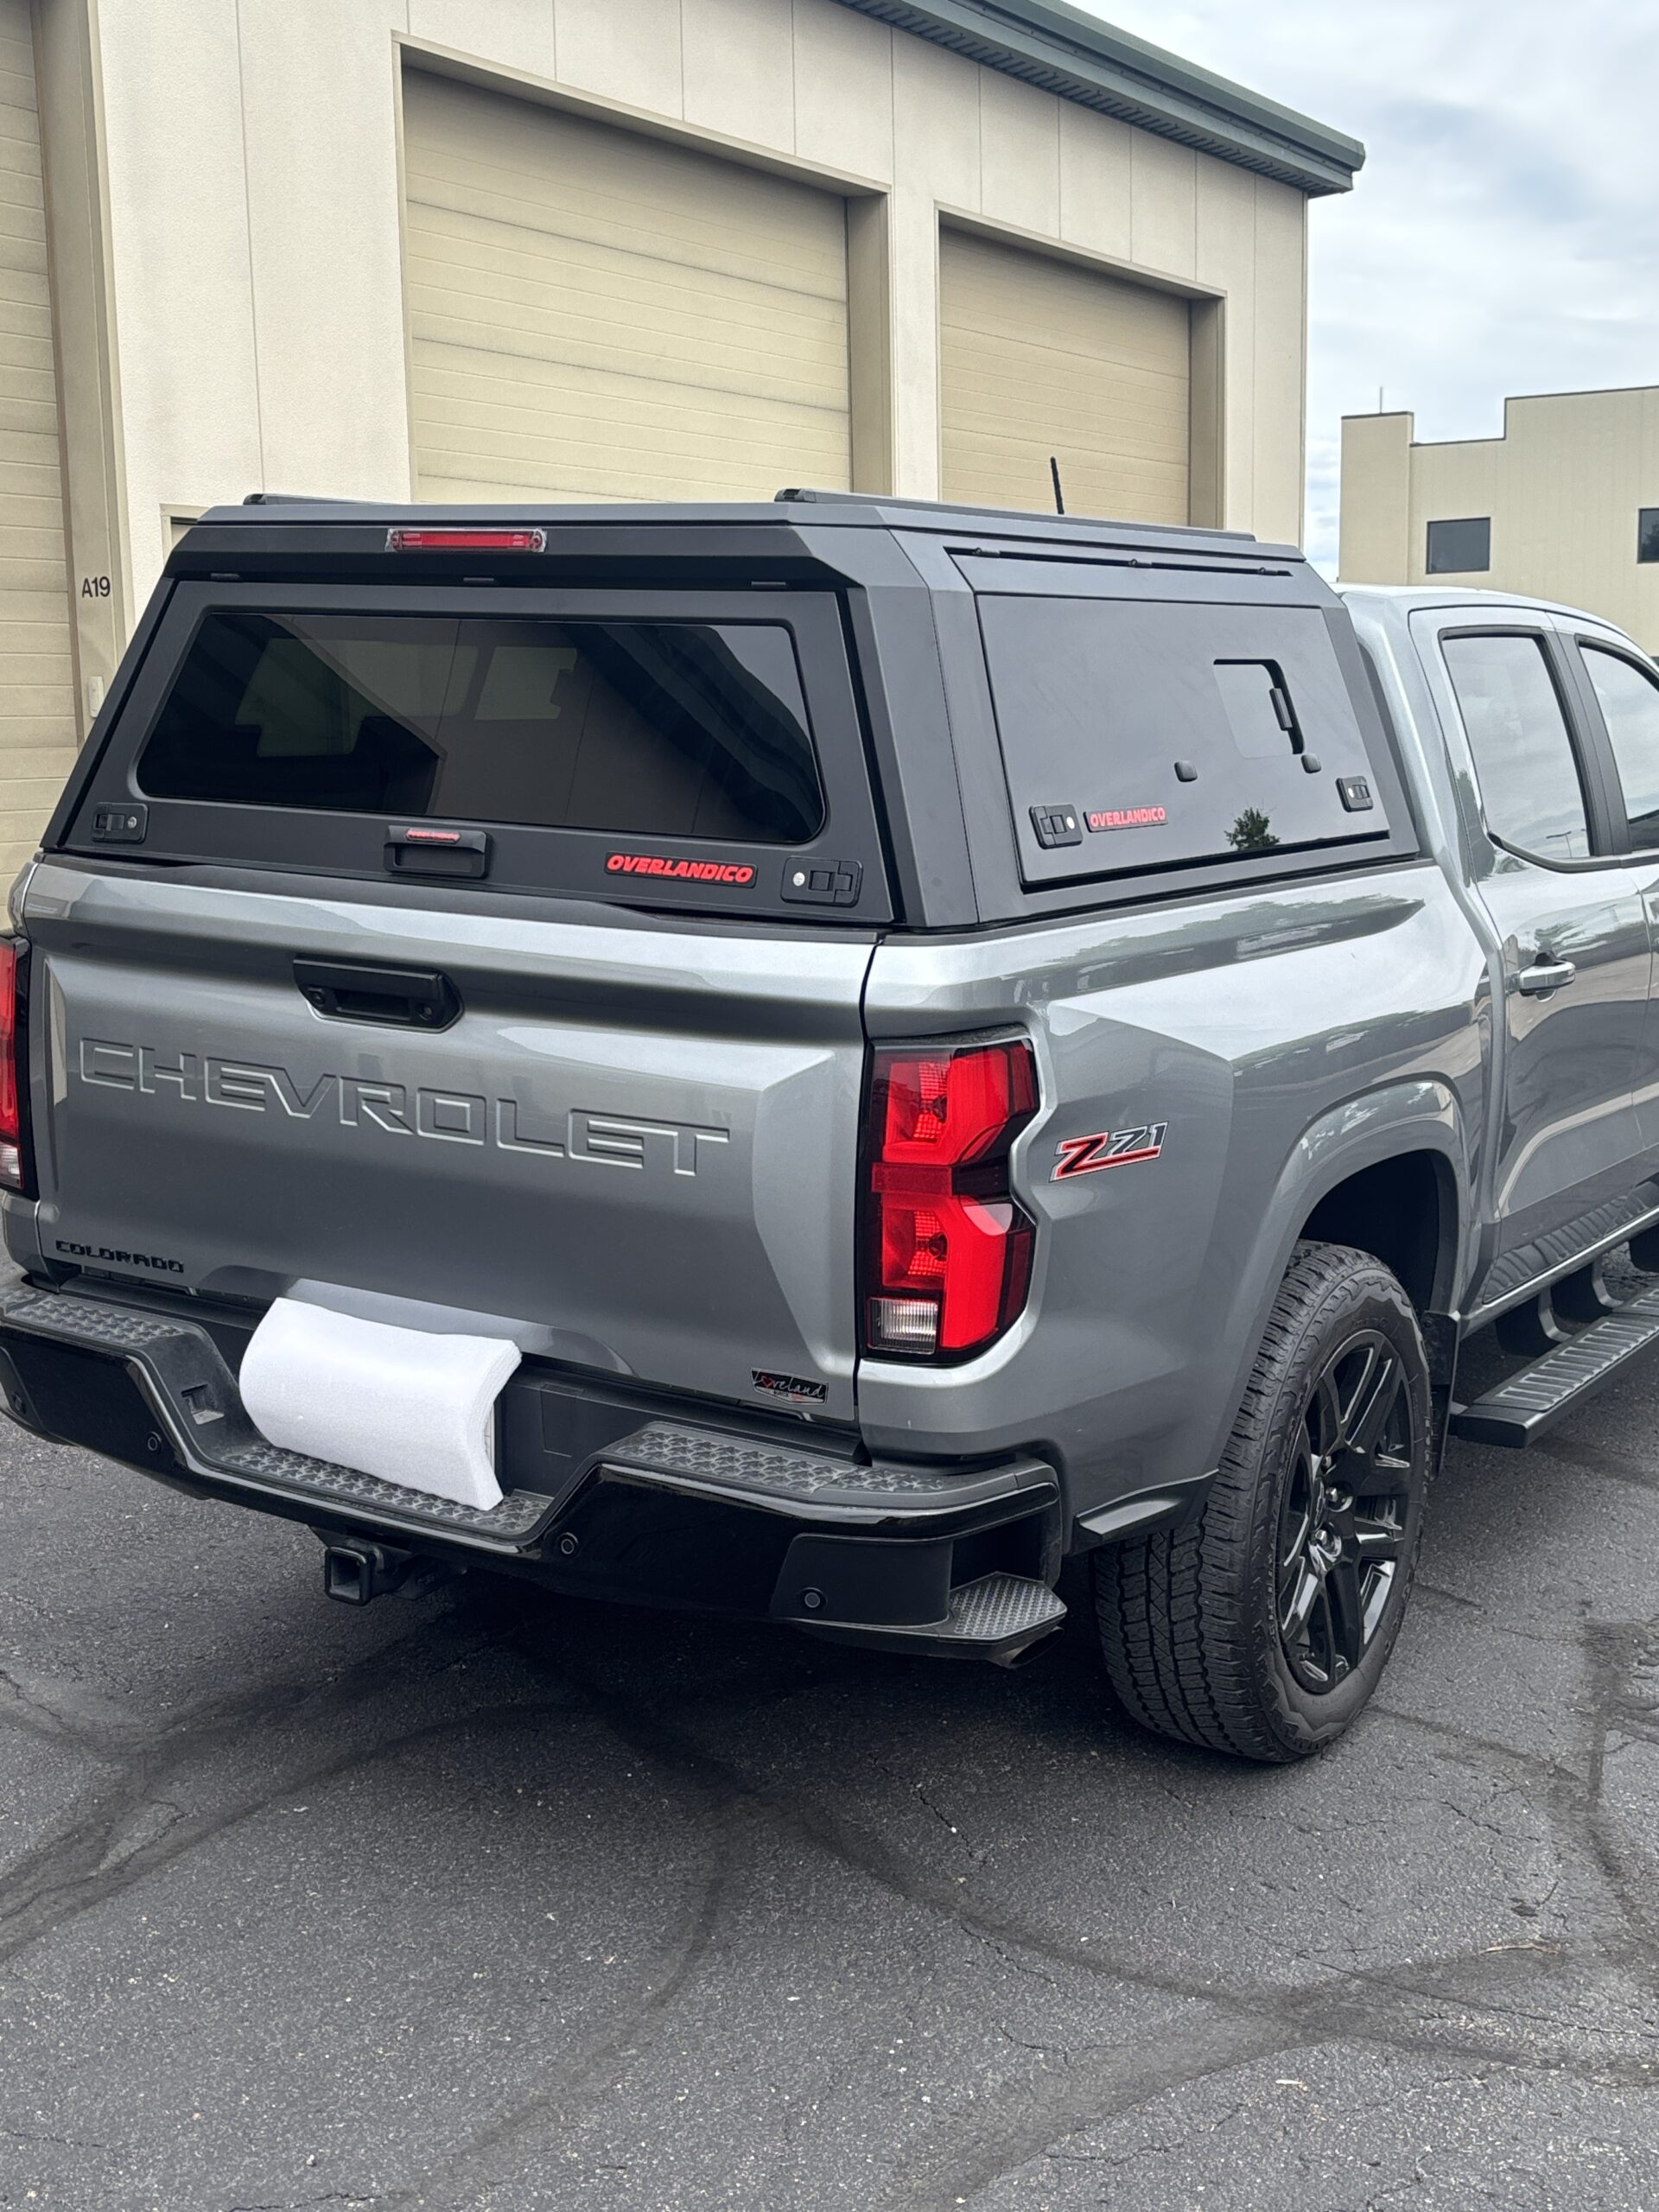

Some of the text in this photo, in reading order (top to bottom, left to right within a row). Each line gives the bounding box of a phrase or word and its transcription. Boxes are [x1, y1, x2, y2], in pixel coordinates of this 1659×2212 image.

[81, 575, 111, 598] A19
[1090, 806, 1166, 828] OVERLANDICO
[607, 854, 753, 883] OVERLANDICO
[79, 1037, 731, 1177] CHEVROLET
[1049, 1121, 1169, 1183] Z71
[55, 1239, 184, 1274] COLORADO
